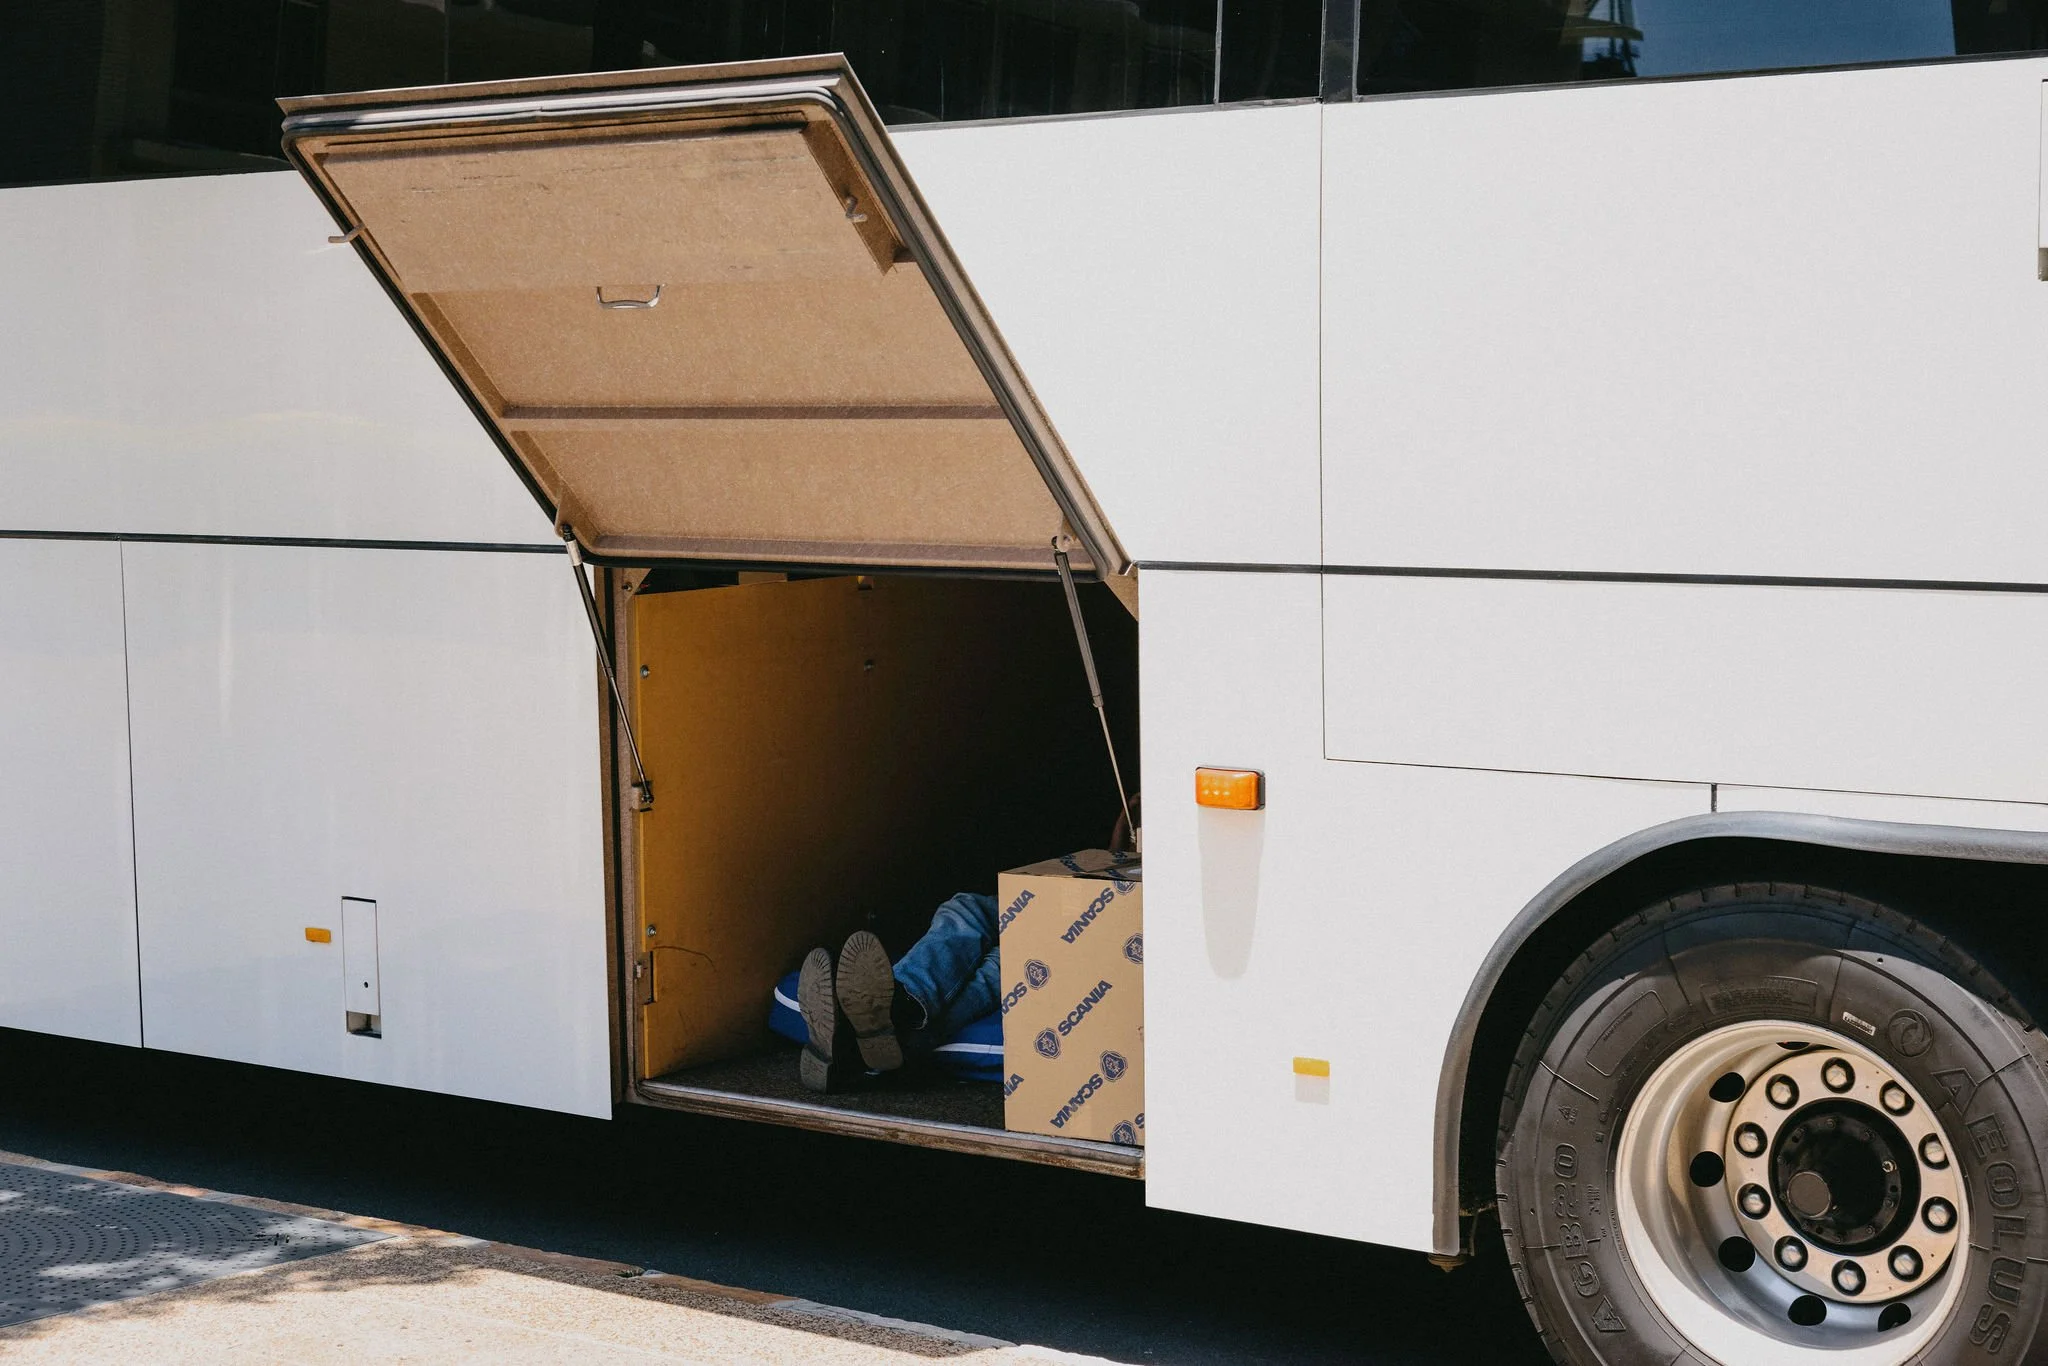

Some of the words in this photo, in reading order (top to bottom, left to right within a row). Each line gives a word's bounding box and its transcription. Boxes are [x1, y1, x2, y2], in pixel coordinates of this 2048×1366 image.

[1060, 887, 1115, 944] SCANIA
[1058, 979, 1113, 1037] SCANIA
[1050, 1073, 1103, 1129] SCANIA
[1931, 1067, 2027, 1354] AEOLUS
